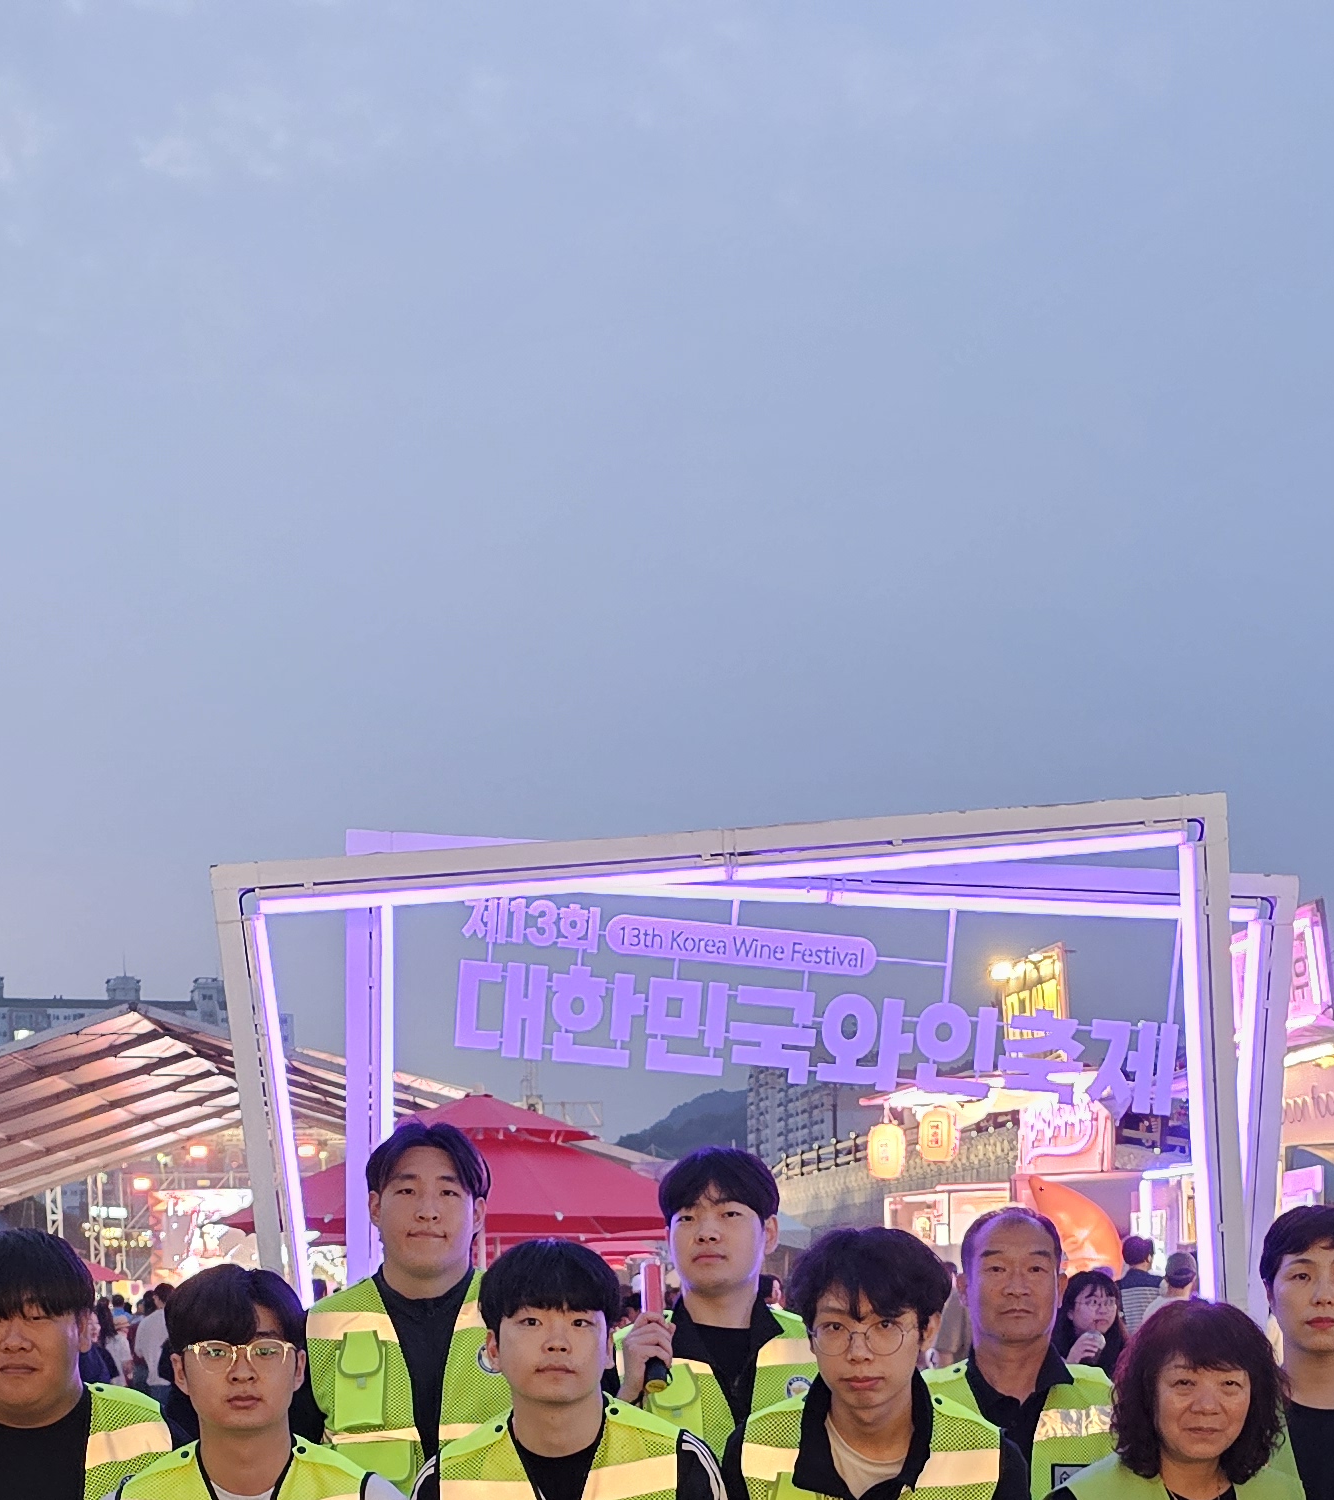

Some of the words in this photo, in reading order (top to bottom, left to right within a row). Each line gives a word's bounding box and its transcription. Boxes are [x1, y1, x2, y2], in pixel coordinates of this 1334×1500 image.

[461, 897, 601, 954] 제13회
[617, 924, 664, 951] 13th
[669, 929, 728, 957] Korea
[732, 935, 786, 963] Wine
[789, 941, 866, 970] Festival
